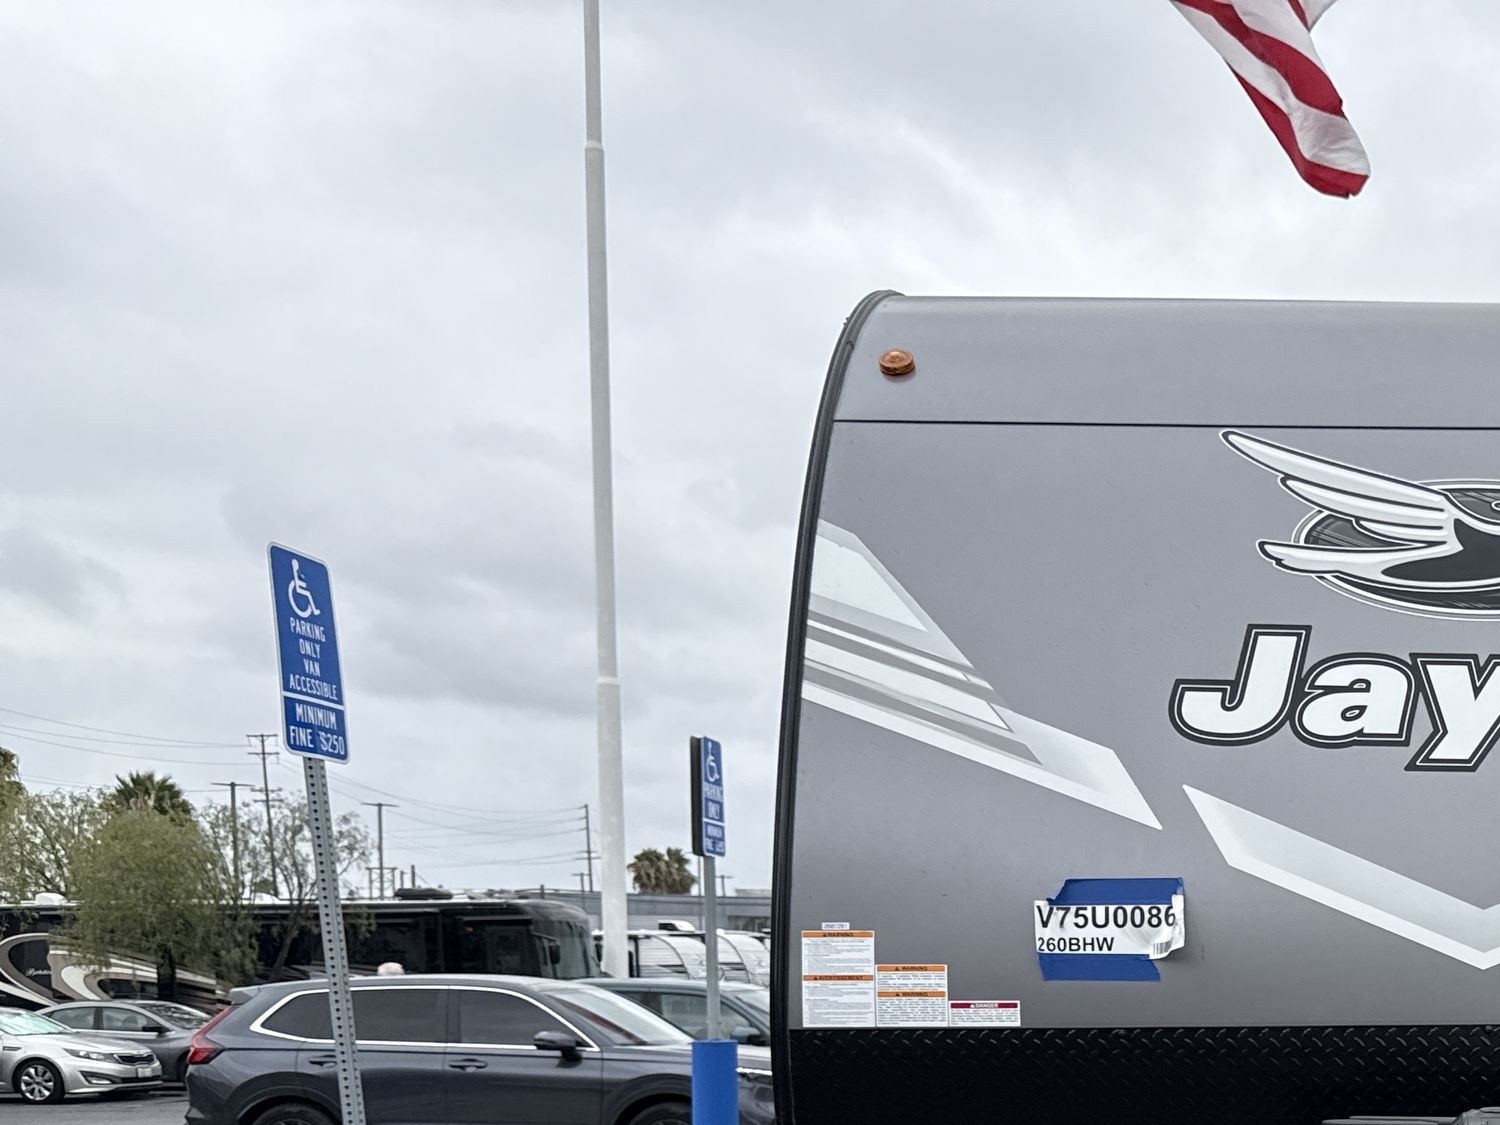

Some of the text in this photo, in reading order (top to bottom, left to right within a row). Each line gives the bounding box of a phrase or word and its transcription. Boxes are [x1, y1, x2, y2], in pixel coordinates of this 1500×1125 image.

[289, 616, 326, 642] PARKING
[299, 638, 321, 659] ONLY
[303, 660, 321, 677] VAN
[289, 673, 338, 701] ACCESSIBLE
[295, 702, 337, 730] MINIMUM
[289, 725, 345, 755] FINE $250
[1036, 904, 1176, 929] V75U0086
[1038, 936, 1115, 952] 260BHW
